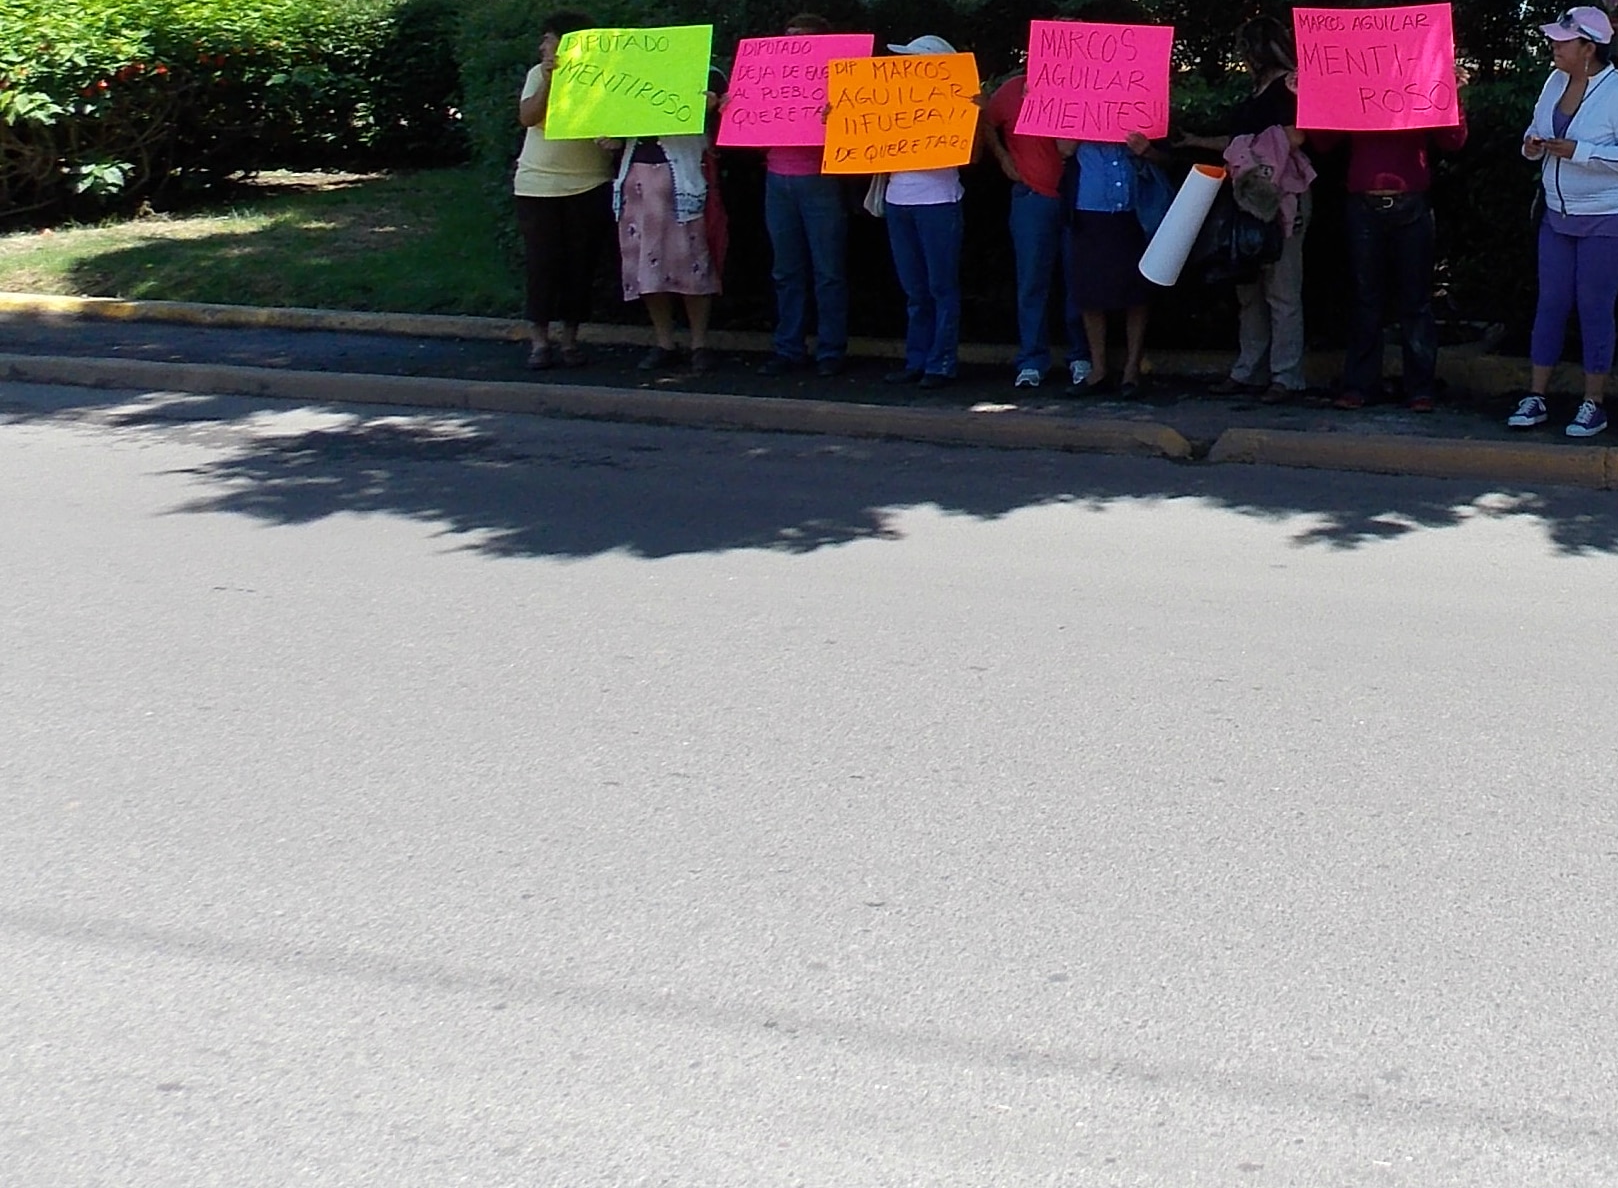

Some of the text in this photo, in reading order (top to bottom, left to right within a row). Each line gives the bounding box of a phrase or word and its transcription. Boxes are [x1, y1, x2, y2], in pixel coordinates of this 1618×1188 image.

[1299, 12, 1430, 34] MARCOS AGUILAR
[564, 34, 670, 54] DIPUTADO
[742, 40, 812, 57] DIPUTADO
[1040, 27, 1138, 63] MARCOS
[737, 65, 775, 85] DEJA
[782, 65, 800, 79] DE
[834, 59, 950, 82] DIP MARCOS
[1034, 63, 1151, 92] AGUILAR
[558, 57, 692, 122] MENTIROSO
[732, 85, 826, 101] AL PUEBLO
[836, 83, 973, 108] AGUILAR
[1358, 80, 1451, 113] ROSO
[731, 105, 824, 131] QUERETA
[834, 135, 969, 164] DE QUERETARO
